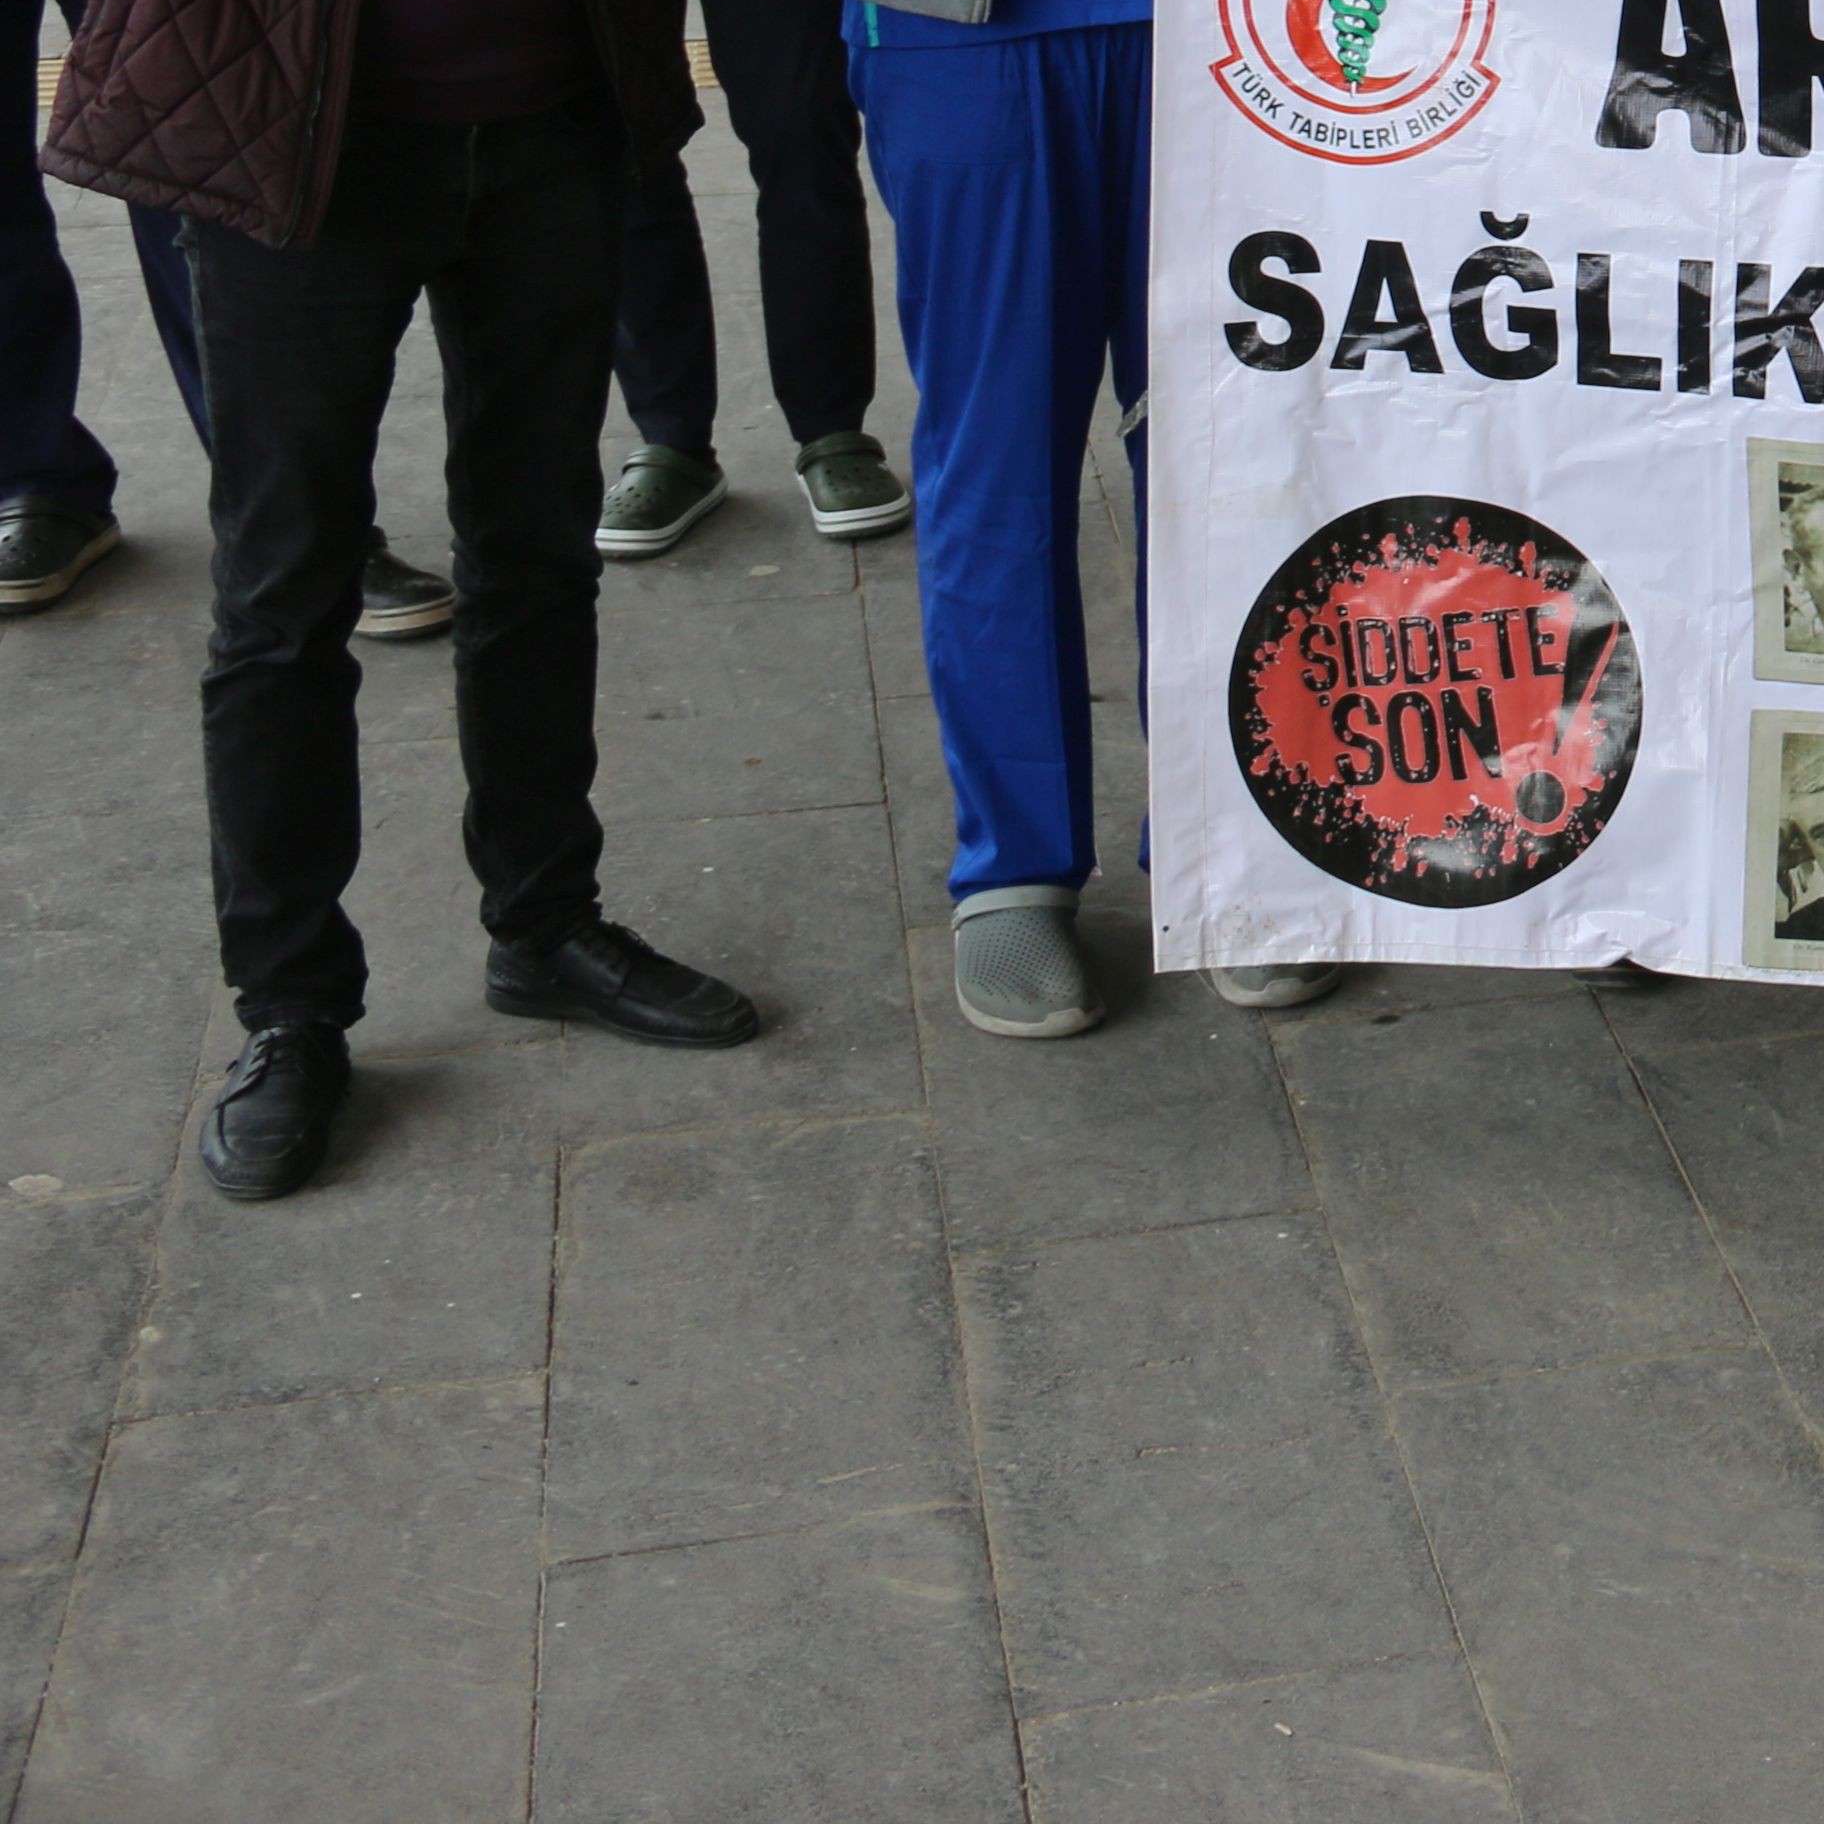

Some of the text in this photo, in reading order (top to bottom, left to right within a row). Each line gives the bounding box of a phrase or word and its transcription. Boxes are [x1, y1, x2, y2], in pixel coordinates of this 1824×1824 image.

[1232, 62, 1482, 150] TÜRK TABİPLERİ BİRLİĞİ
[1300, 603, 1566, 707] ŞİDDETE
